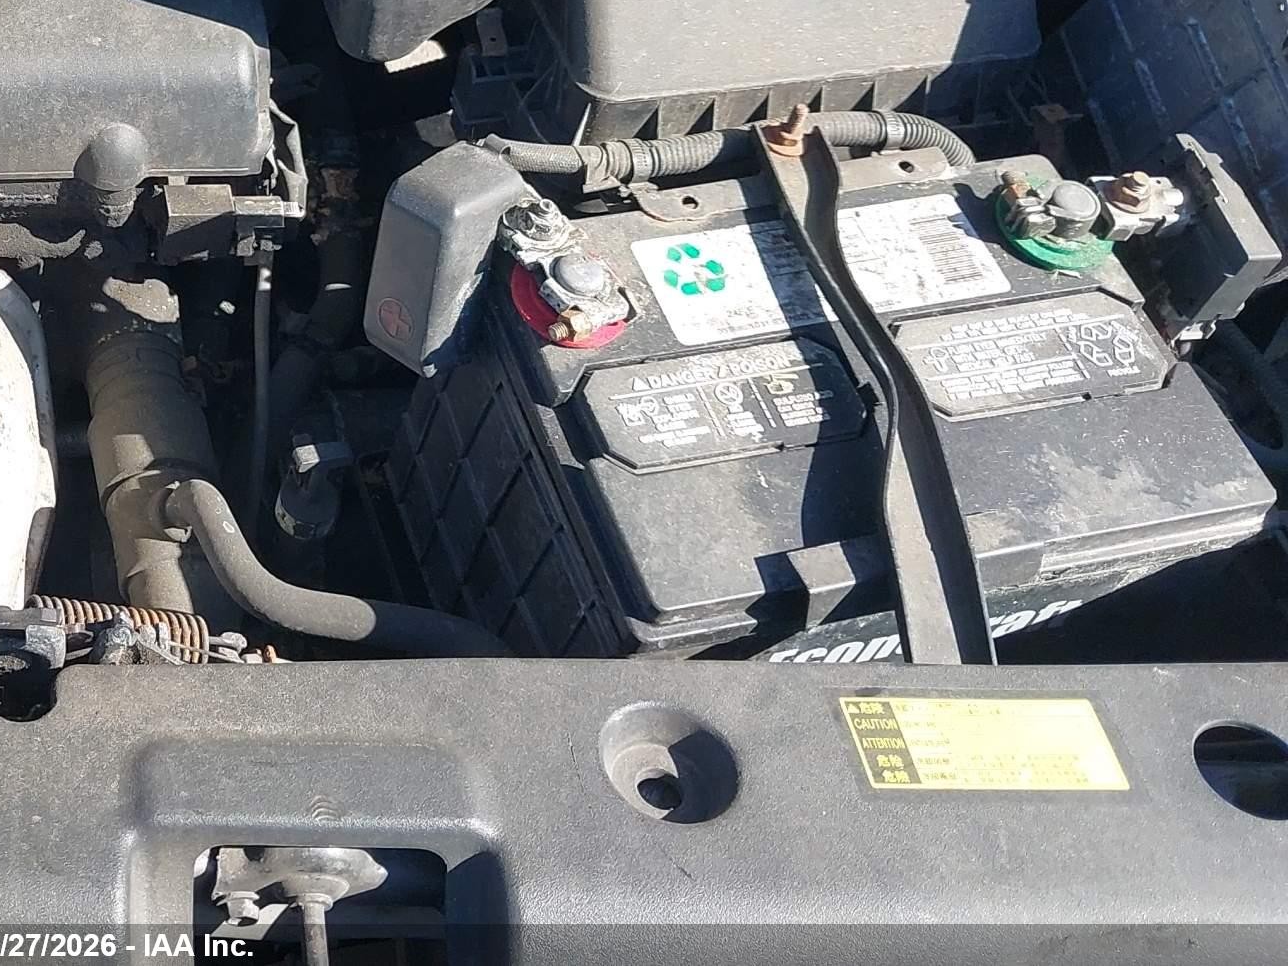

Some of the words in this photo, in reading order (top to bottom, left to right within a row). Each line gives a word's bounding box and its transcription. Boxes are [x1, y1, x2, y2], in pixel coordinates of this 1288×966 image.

[650, 368, 715, 389] DANGER
[728, 357, 792, 377] POISON
[854, 718, 900, 730] CAUTION
[862, 737, 906, 749] ATTENTION
